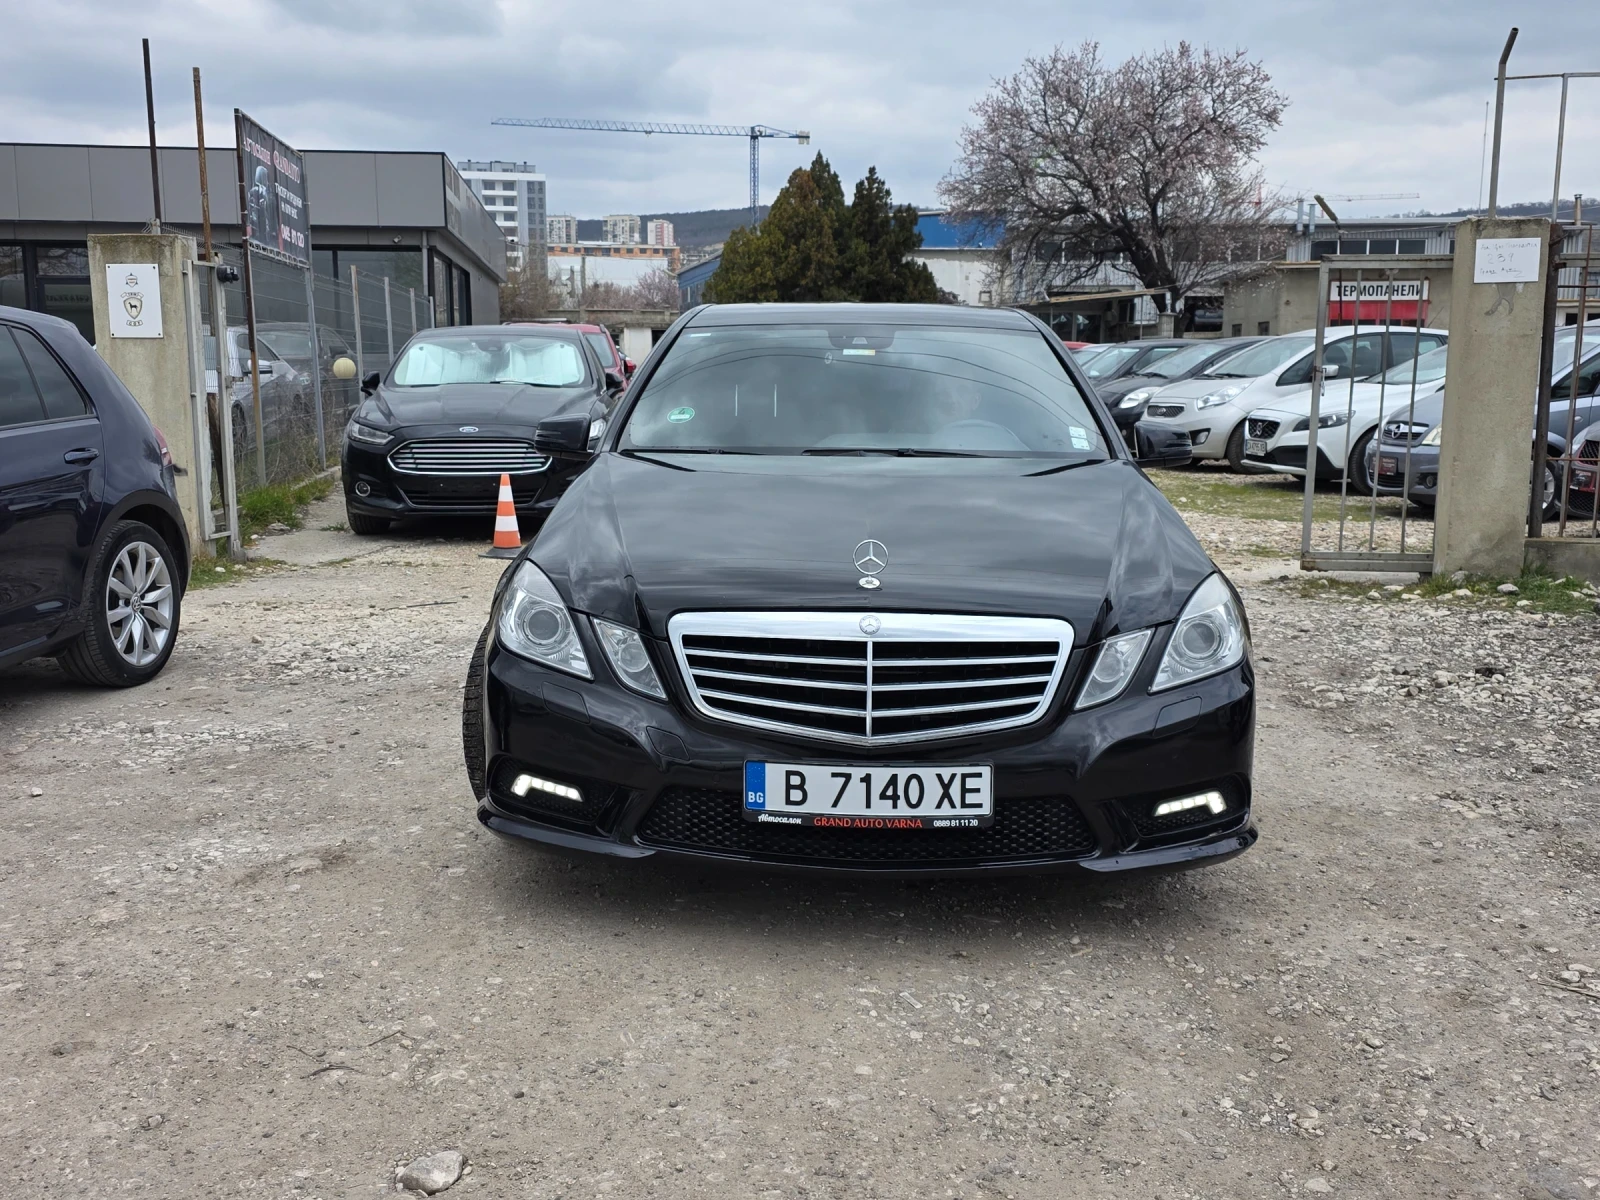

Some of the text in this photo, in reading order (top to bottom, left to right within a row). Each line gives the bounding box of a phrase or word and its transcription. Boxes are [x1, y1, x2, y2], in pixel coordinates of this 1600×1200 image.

[1336, 284, 1421, 297] ТЕРМОПАНЕЛИ
[785, 770, 983, 809] B 7140 XE
[748, 791, 764, 803] BG
[814, 817, 923, 829] GRAND AUTO VARNA
